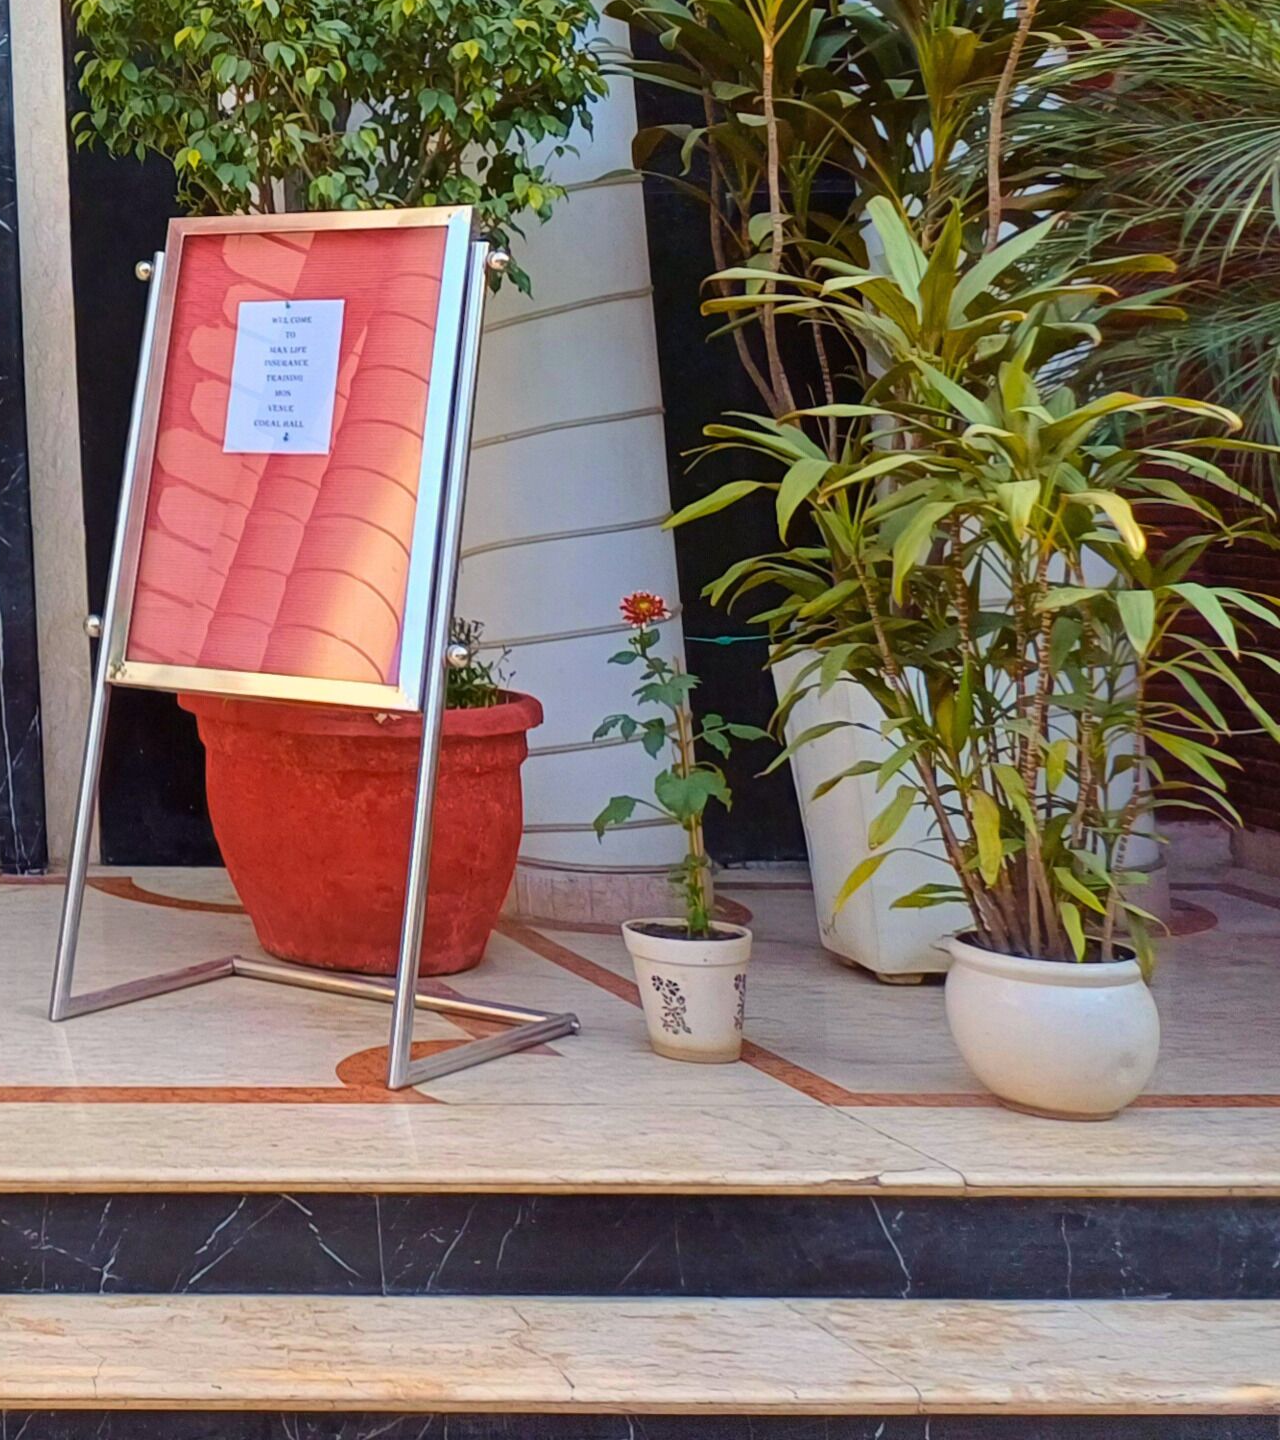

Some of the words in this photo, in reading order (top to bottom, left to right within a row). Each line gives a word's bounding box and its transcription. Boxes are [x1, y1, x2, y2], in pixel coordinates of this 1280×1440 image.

[272, 316, 312, 324] WELCOME
[286, 331, 296, 339] TO
[266, 374, 303, 382] TRAINING
